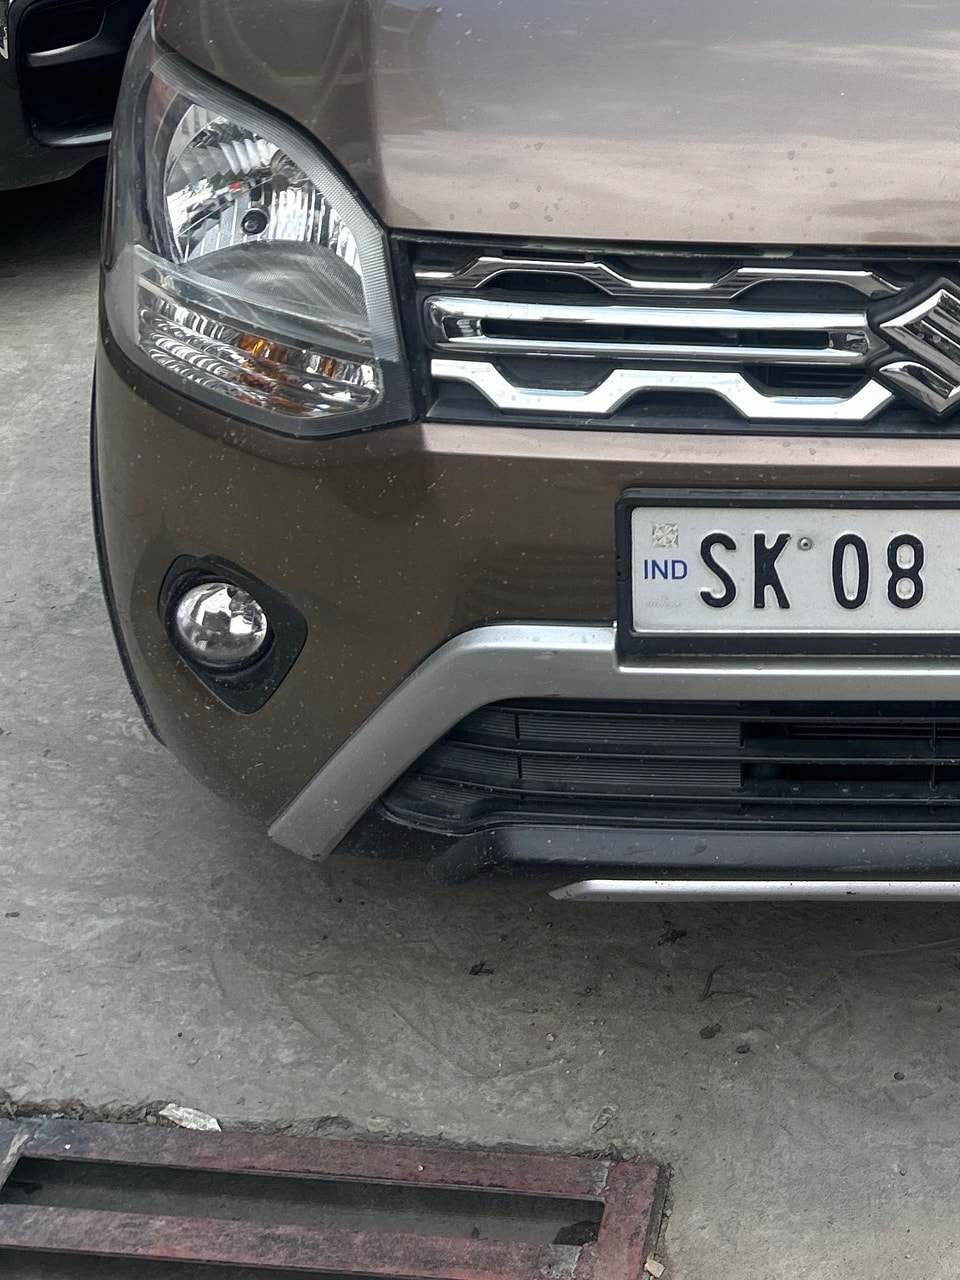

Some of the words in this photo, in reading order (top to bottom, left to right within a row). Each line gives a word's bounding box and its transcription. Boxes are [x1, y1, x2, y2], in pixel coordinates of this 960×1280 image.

[644, 559, 688, 580] IND
[700, 533, 790, 609] SK
[832, 533, 924, 609] 08
